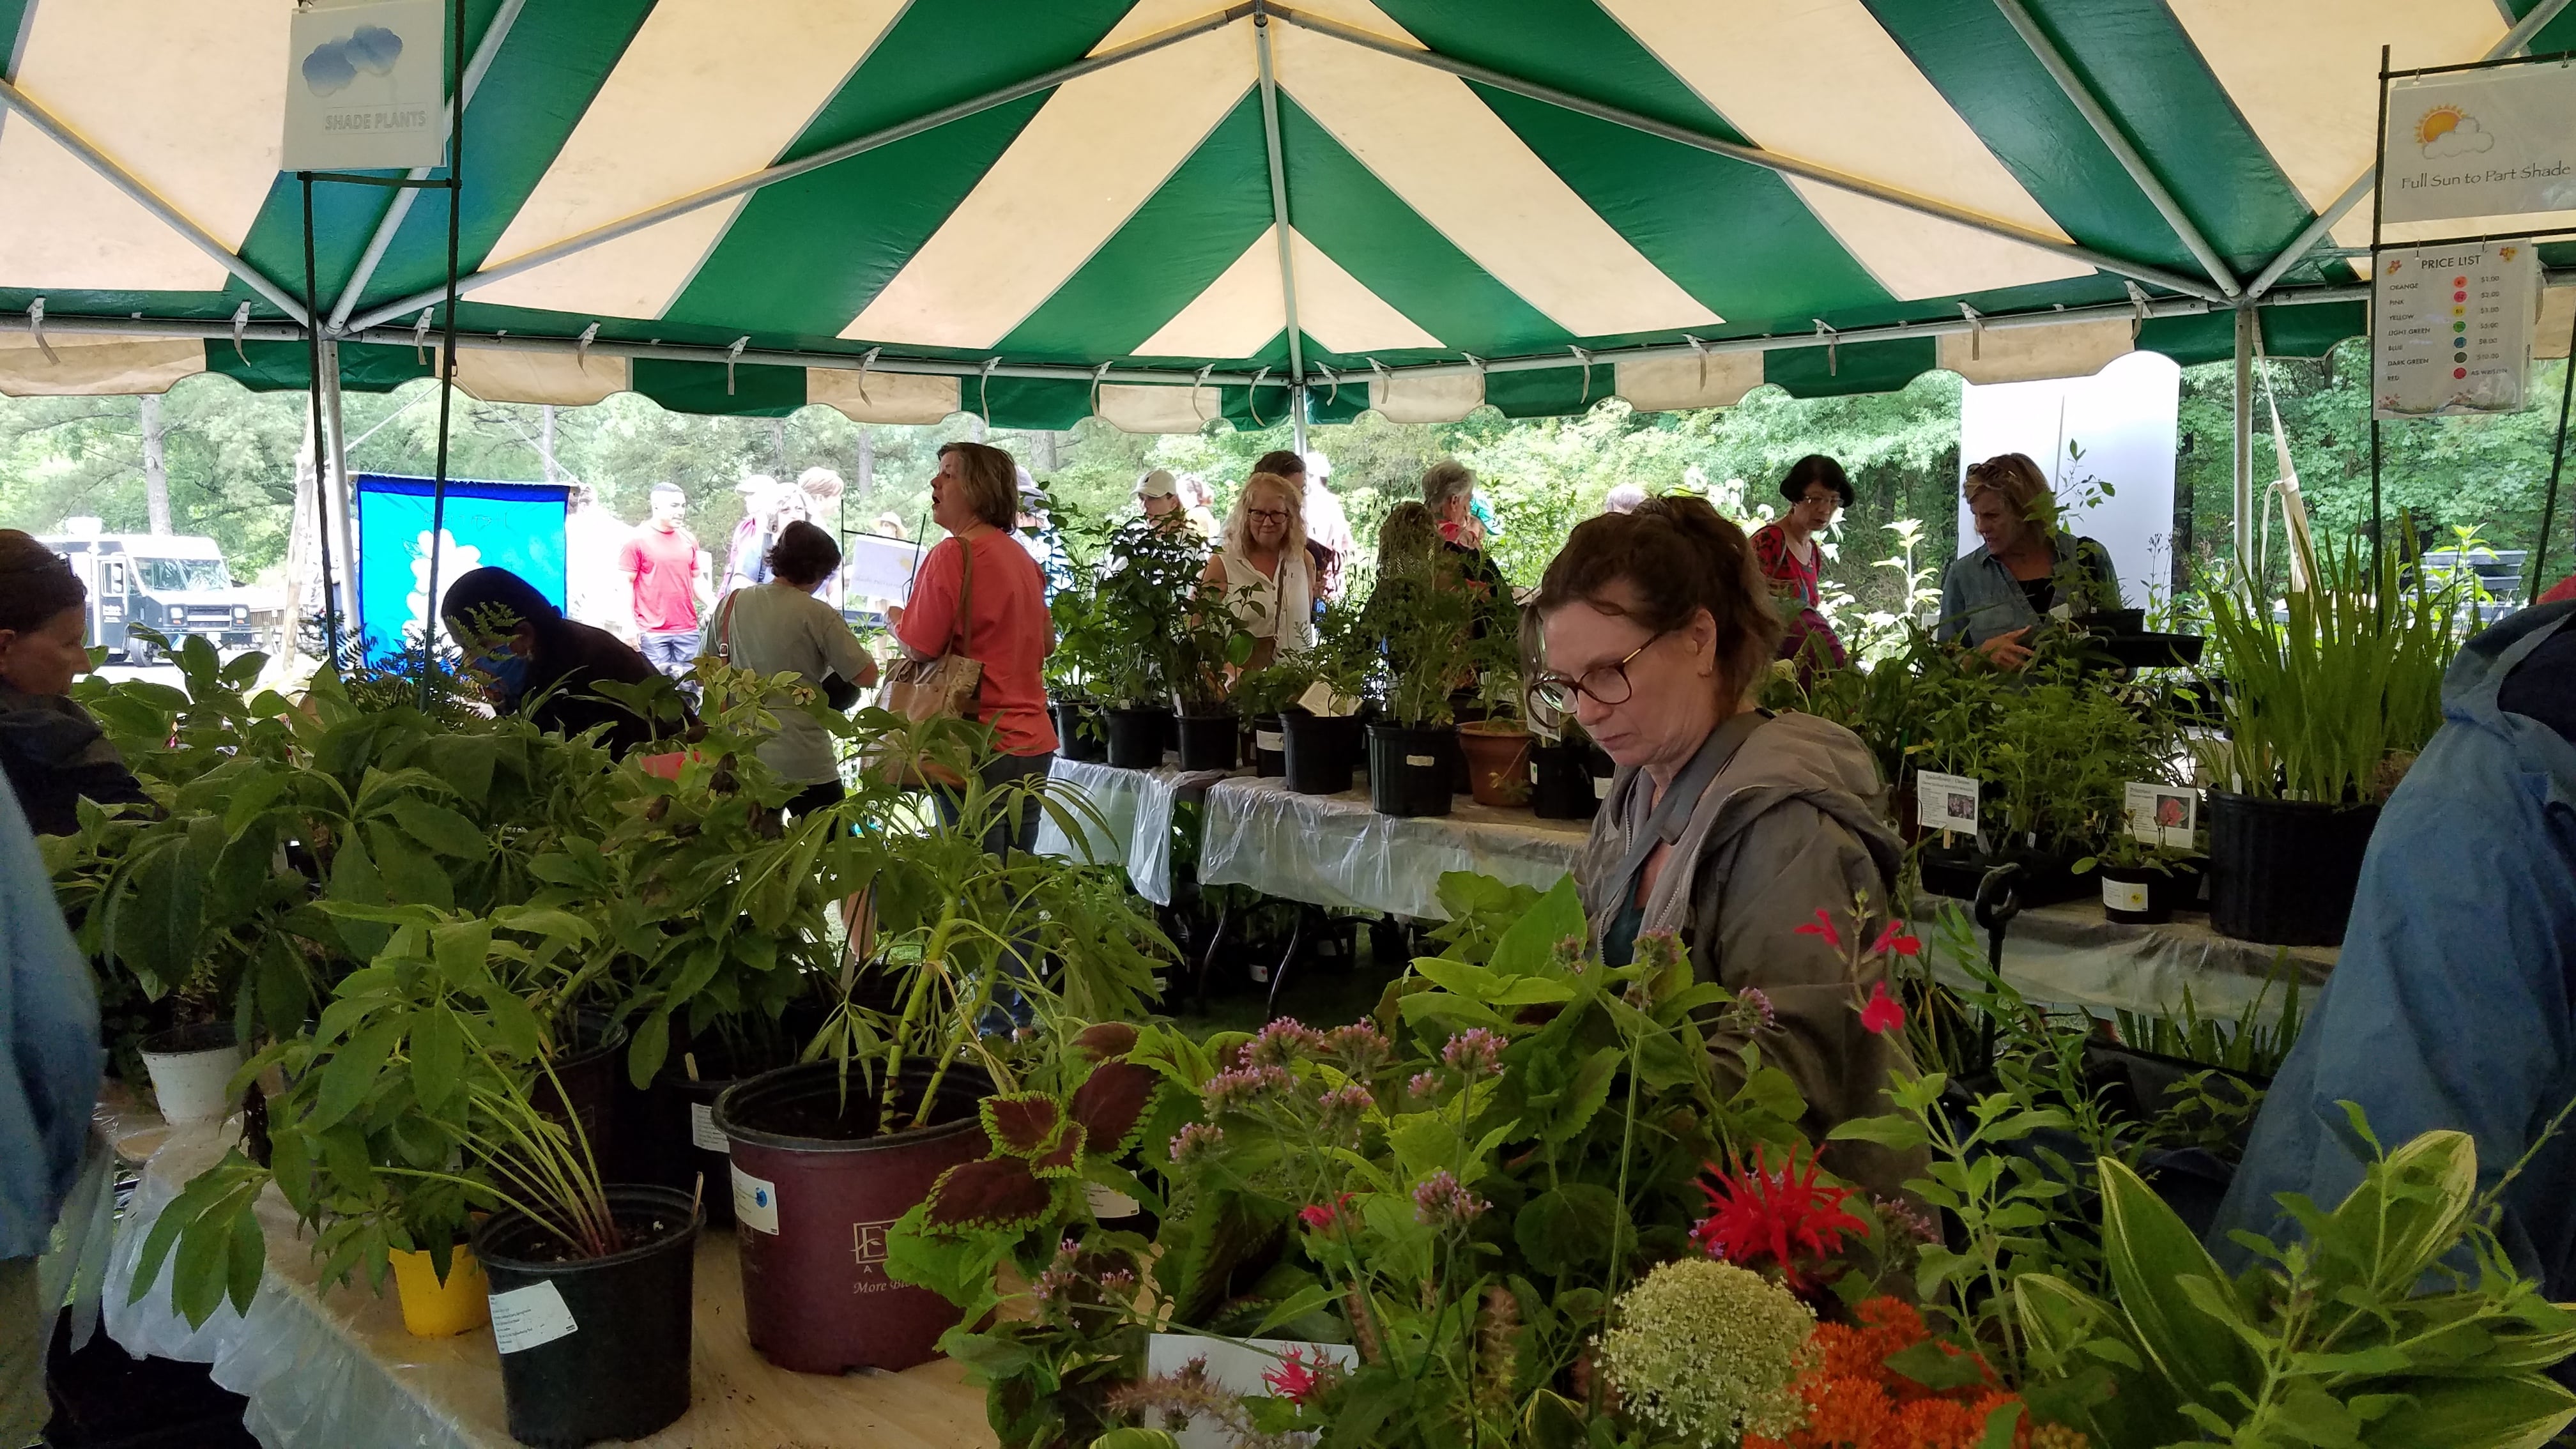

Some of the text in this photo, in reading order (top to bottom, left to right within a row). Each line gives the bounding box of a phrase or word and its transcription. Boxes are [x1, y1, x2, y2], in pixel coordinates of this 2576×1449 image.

[325, 110, 427, 131] SHADE PLANTS
[2401, 160, 2572, 190] Full Sun to Part Shade
[2421, 255, 2481, 269] PRICE LIST
[2389, 282, 2419, 291] ORANGE
[853, 1281, 887, 1294] More
